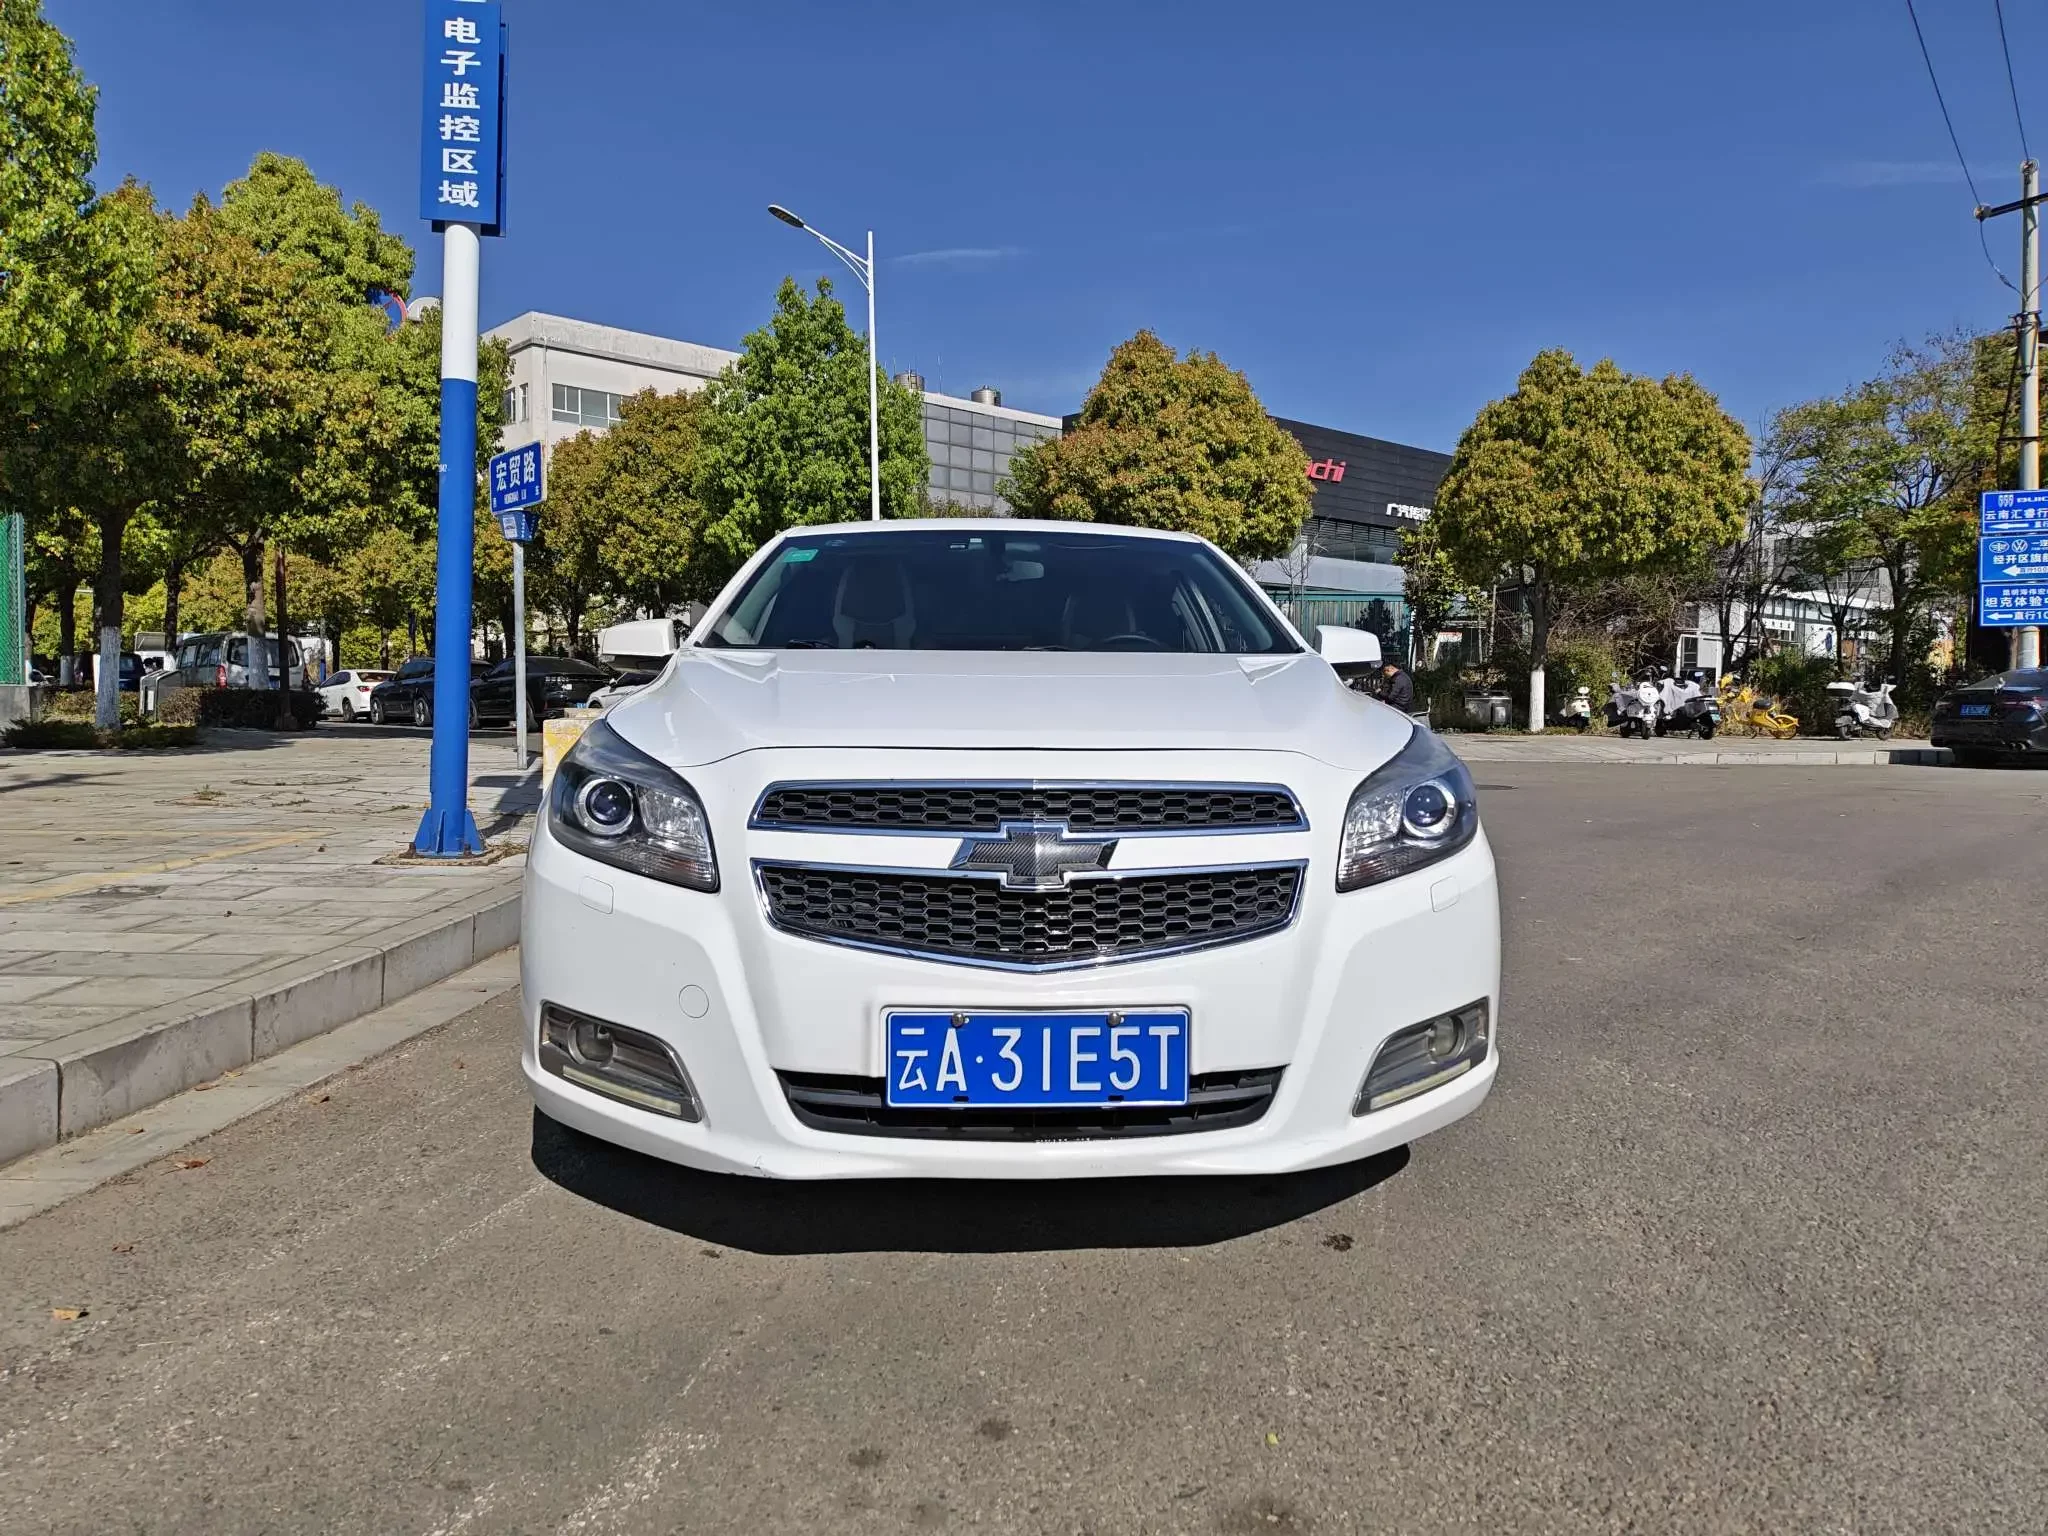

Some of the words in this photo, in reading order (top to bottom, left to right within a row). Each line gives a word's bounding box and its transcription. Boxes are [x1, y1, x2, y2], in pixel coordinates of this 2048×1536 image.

[438, 17, 481, 208] 电子监控区域
[496, 450, 536, 491] 宏贸路
